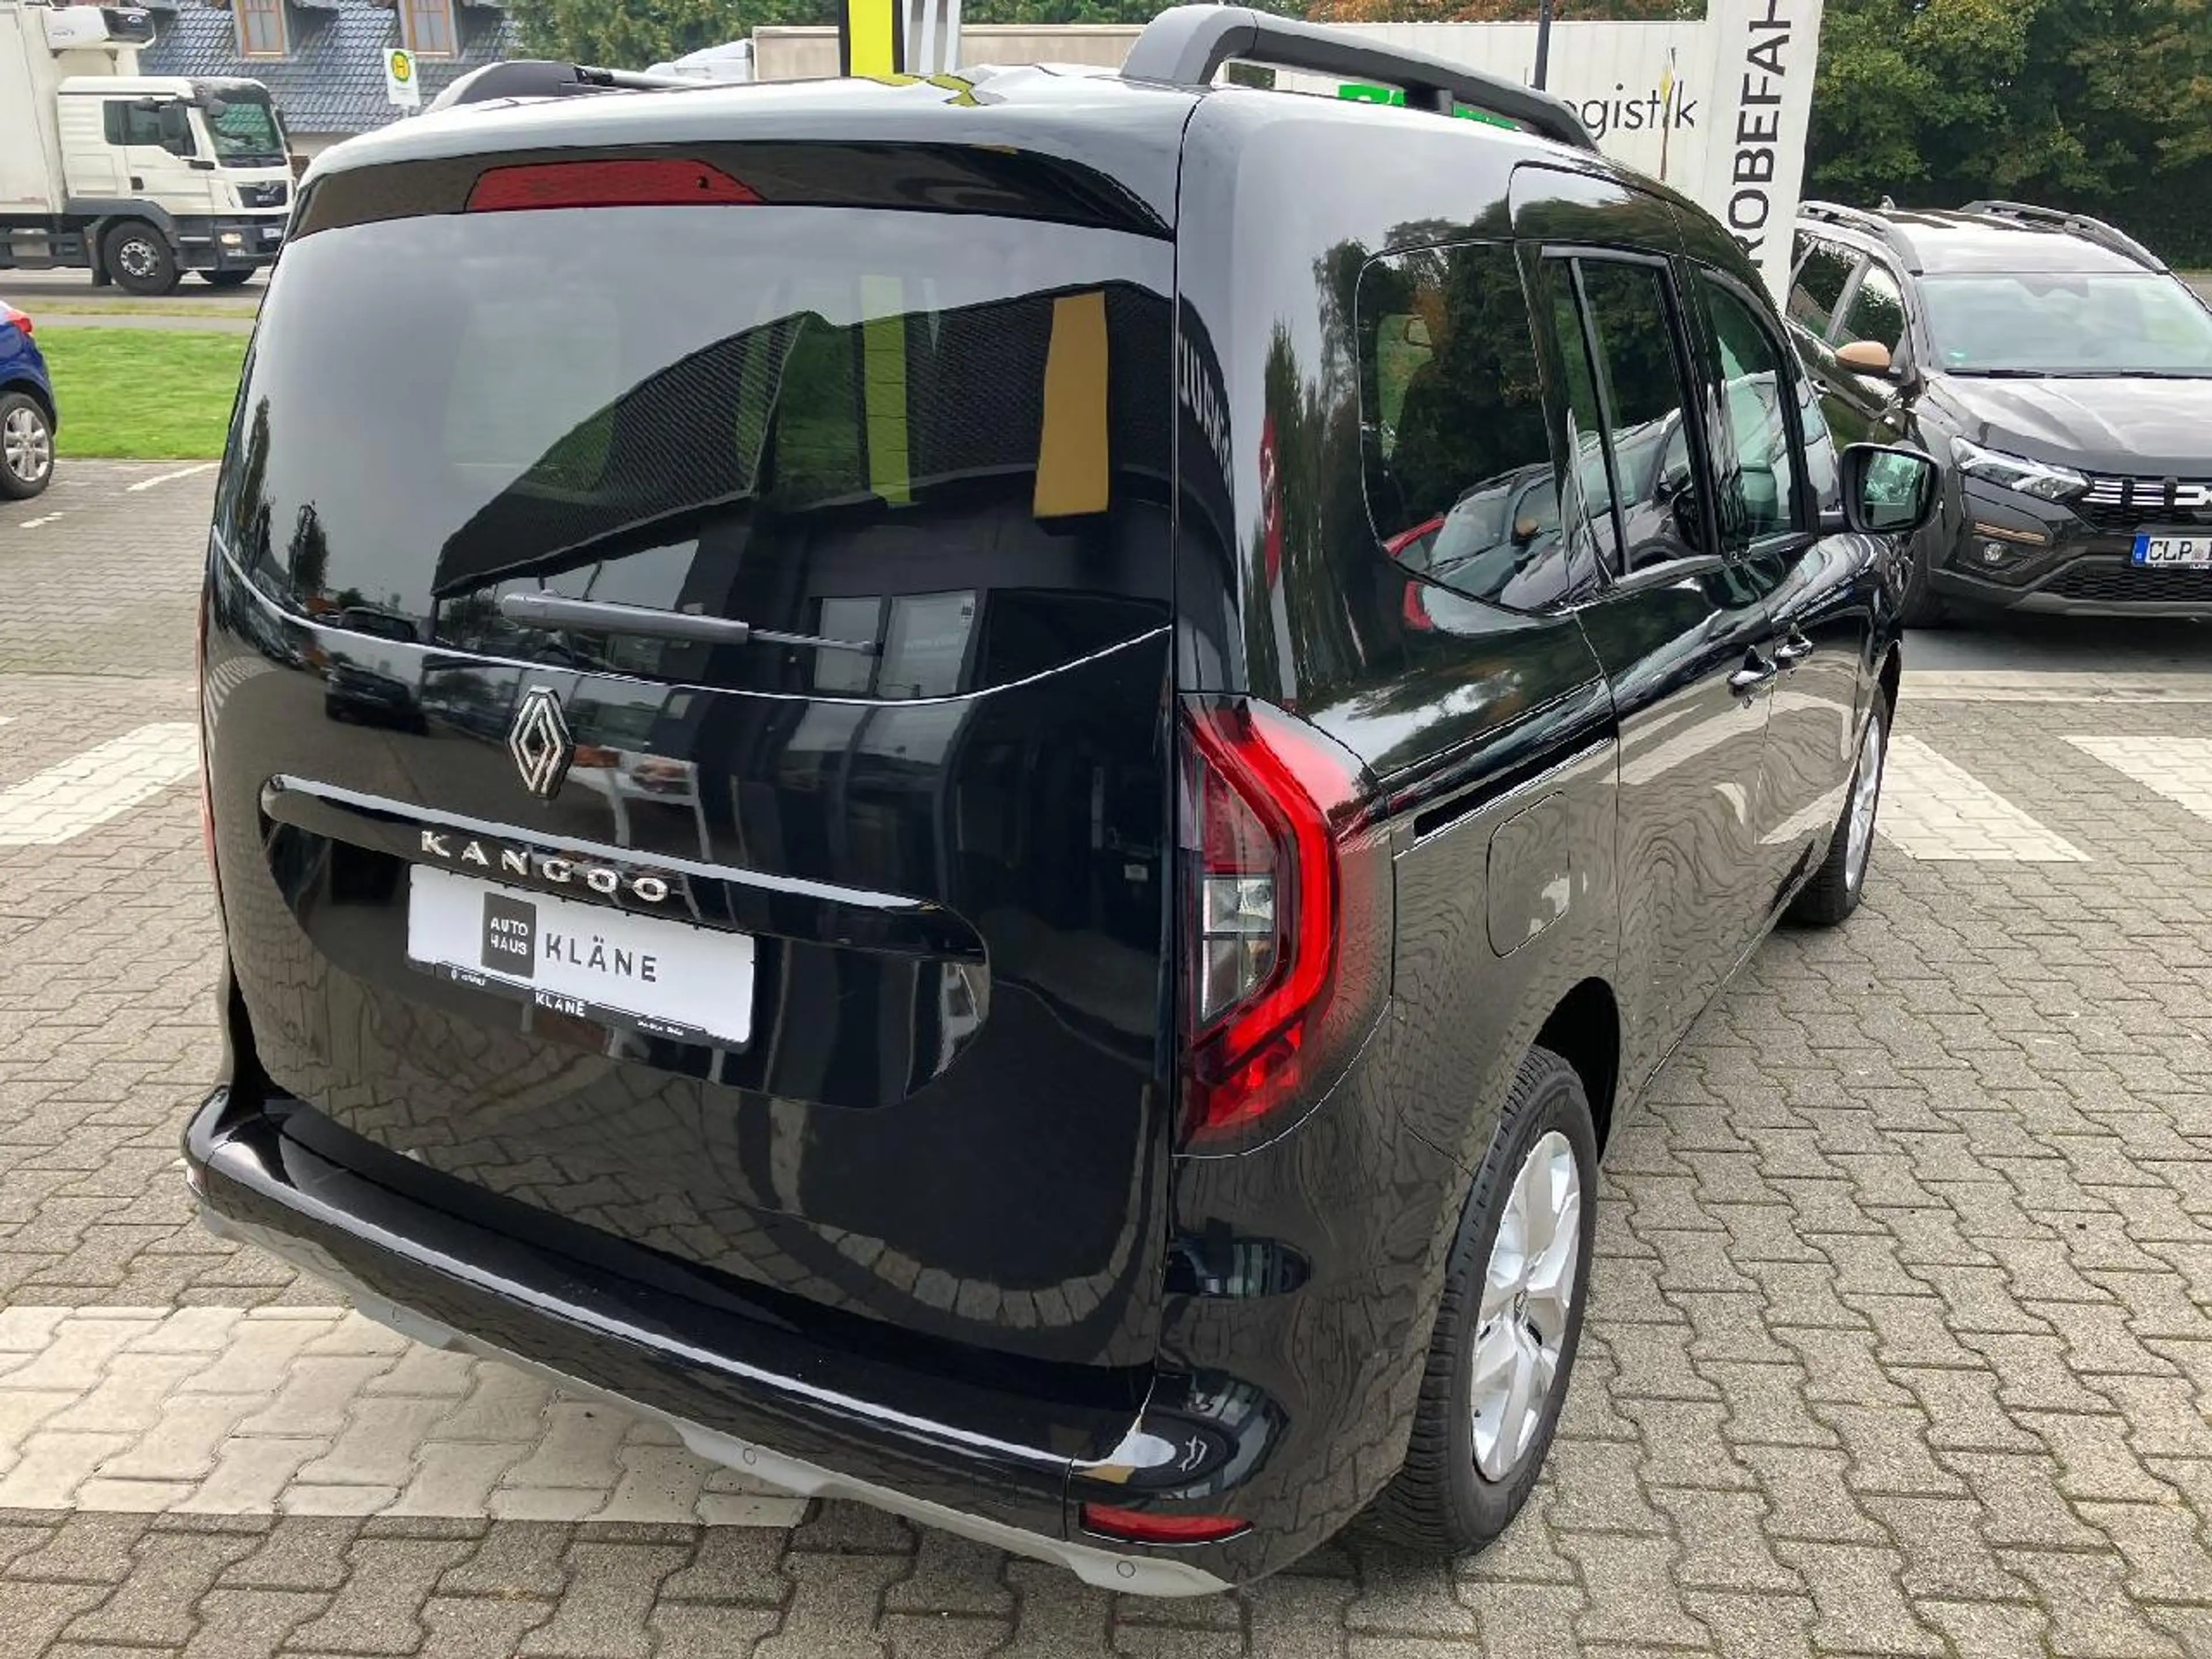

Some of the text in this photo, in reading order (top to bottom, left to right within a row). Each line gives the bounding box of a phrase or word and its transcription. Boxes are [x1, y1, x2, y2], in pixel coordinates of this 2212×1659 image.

[2149, 541, 2192, 560] CLP
[421, 830, 668, 902] KANGOO
[490, 917, 528, 937] AUTO
[490, 933, 527, 956] HAUS
[546, 933, 657, 982] KLÄNE
